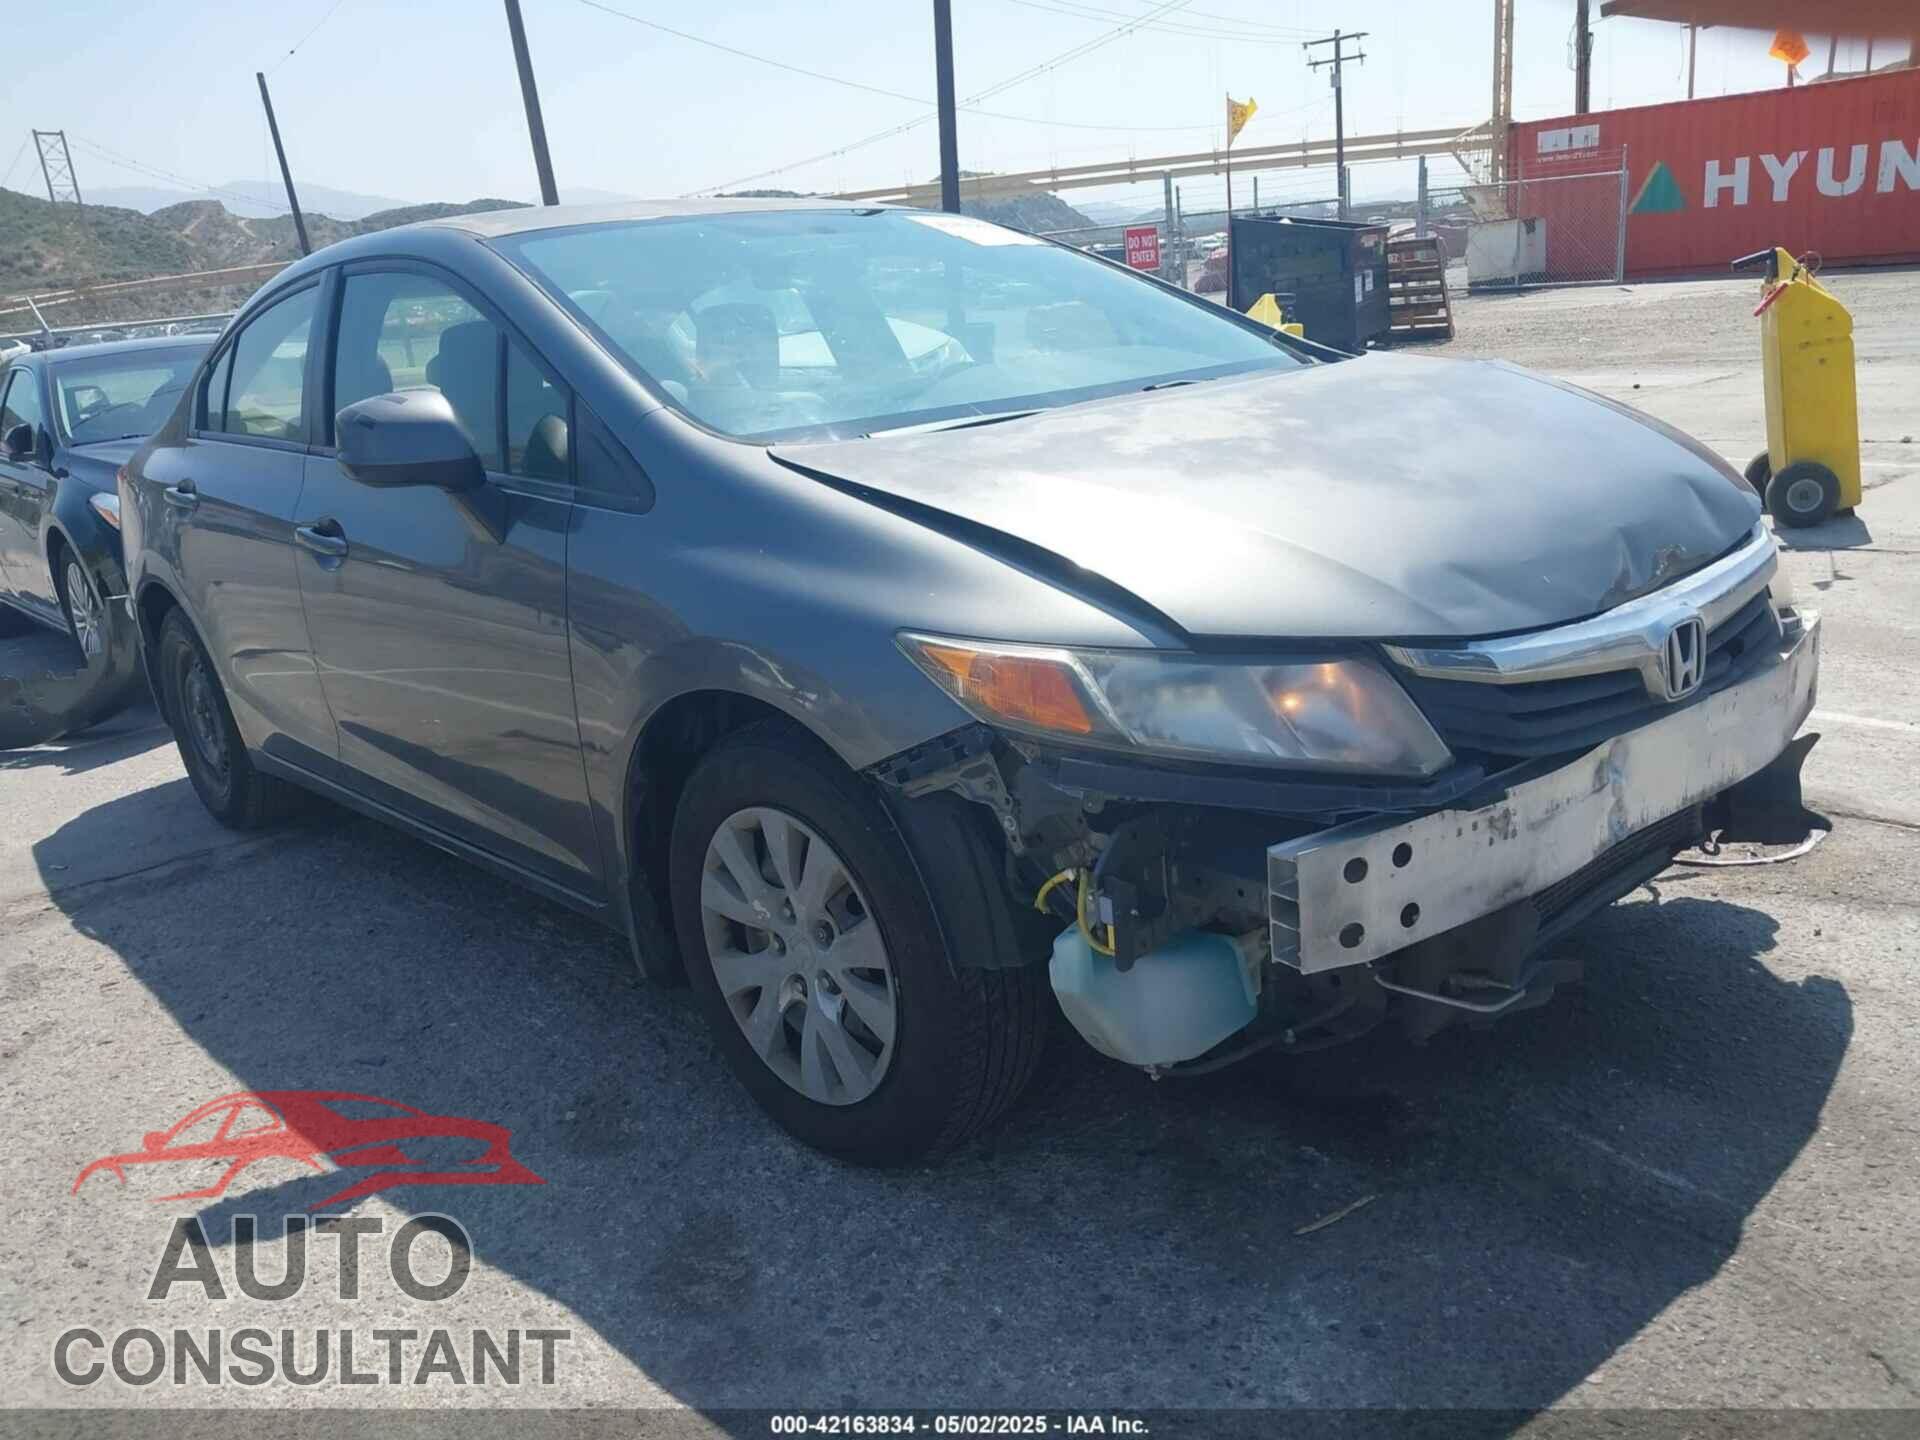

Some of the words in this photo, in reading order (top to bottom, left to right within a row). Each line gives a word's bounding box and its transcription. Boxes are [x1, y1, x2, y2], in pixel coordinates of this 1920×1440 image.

[1704, 138, 1920, 208] HYUN
[1127, 236, 1140, 249] DO
[1140, 234, 1156, 247] NOT
[1131, 249, 1157, 264] ENTER
